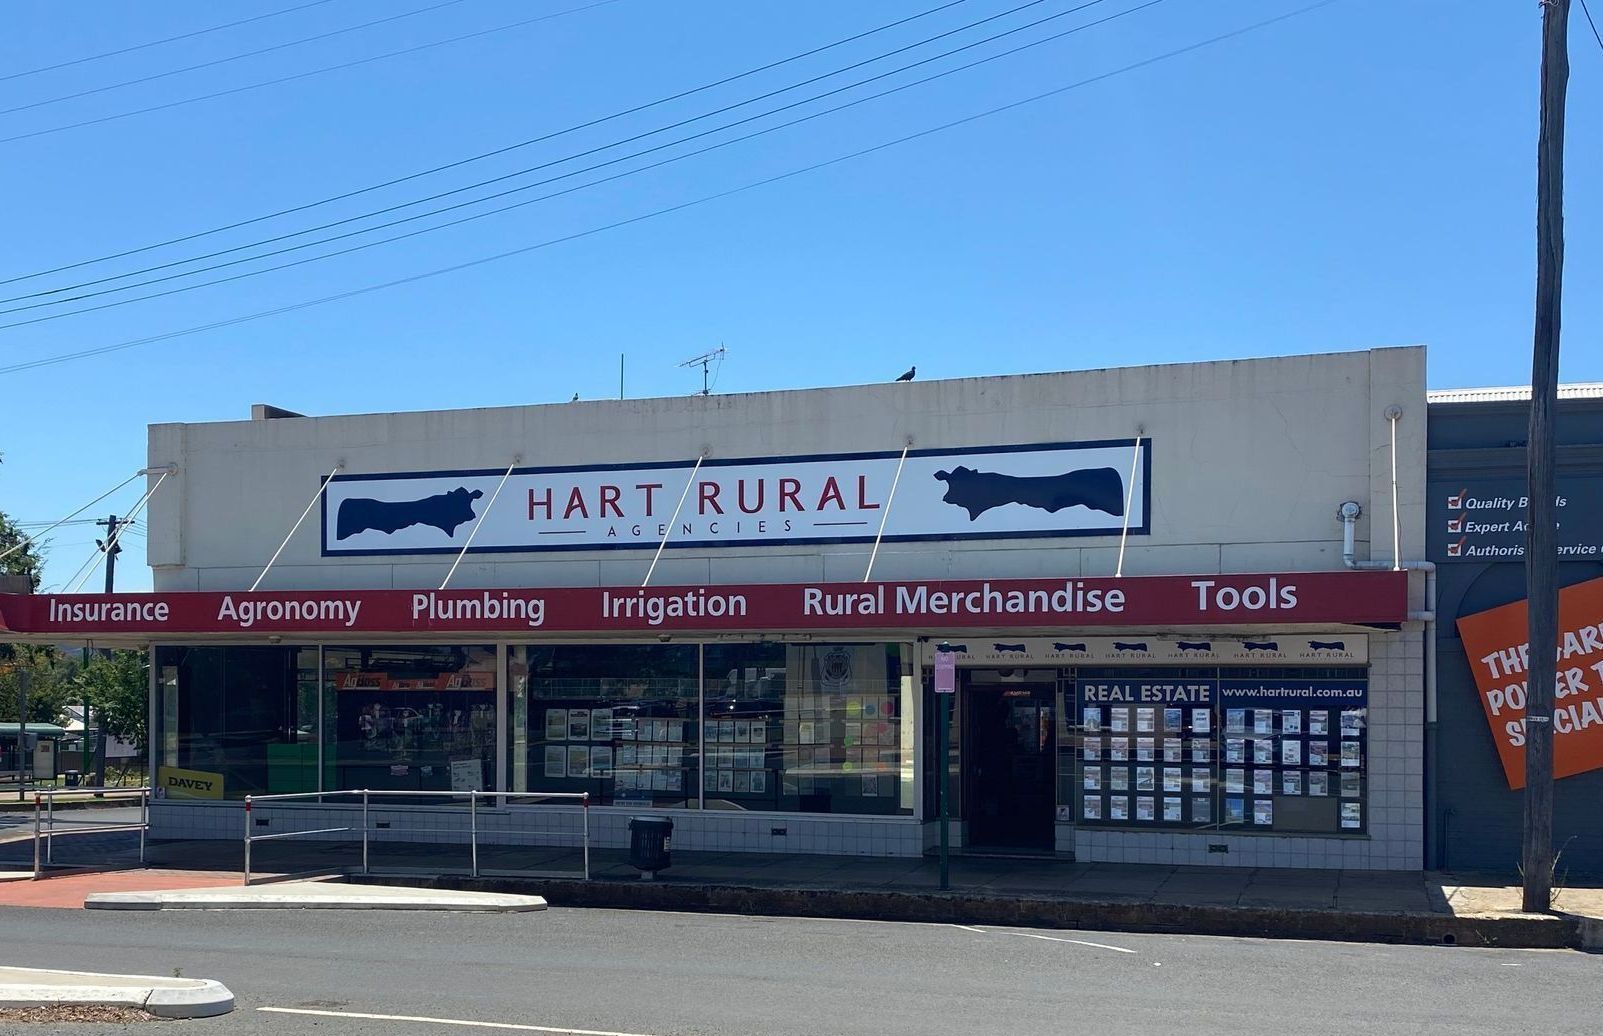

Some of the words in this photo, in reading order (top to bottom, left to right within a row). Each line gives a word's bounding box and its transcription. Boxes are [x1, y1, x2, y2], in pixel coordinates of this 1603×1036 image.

[527, 483, 663, 520] HART
[698, 475, 881, 516] RURAL
[1465, 497, 1515, 511] Quality
[607, 519, 792, 537] AGENCIES
[1465, 521, 1510, 534] Expert
[1466, 544, 1525, 556] Authoris
[1557, 543, 1597, 555] ervice
[803, 584, 885, 615] Rural
[896, 581, 1126, 613] Merchandise
[1191, 577, 1298, 611] Tools
[49, 598, 169, 622] Insurance
[217, 596, 362, 627] Agronomy
[412, 591, 545, 626] Plumbing
[602, 588, 747, 625] Irrigation
[1084, 685, 1134, 701] REAL
[1141, 685, 1210, 701] ESTATE
[1222, 686, 1363, 698] www.hartrural.com.au
[1486, 666, 1590, 716] POER
[168, 776, 213, 792] DAVEY
